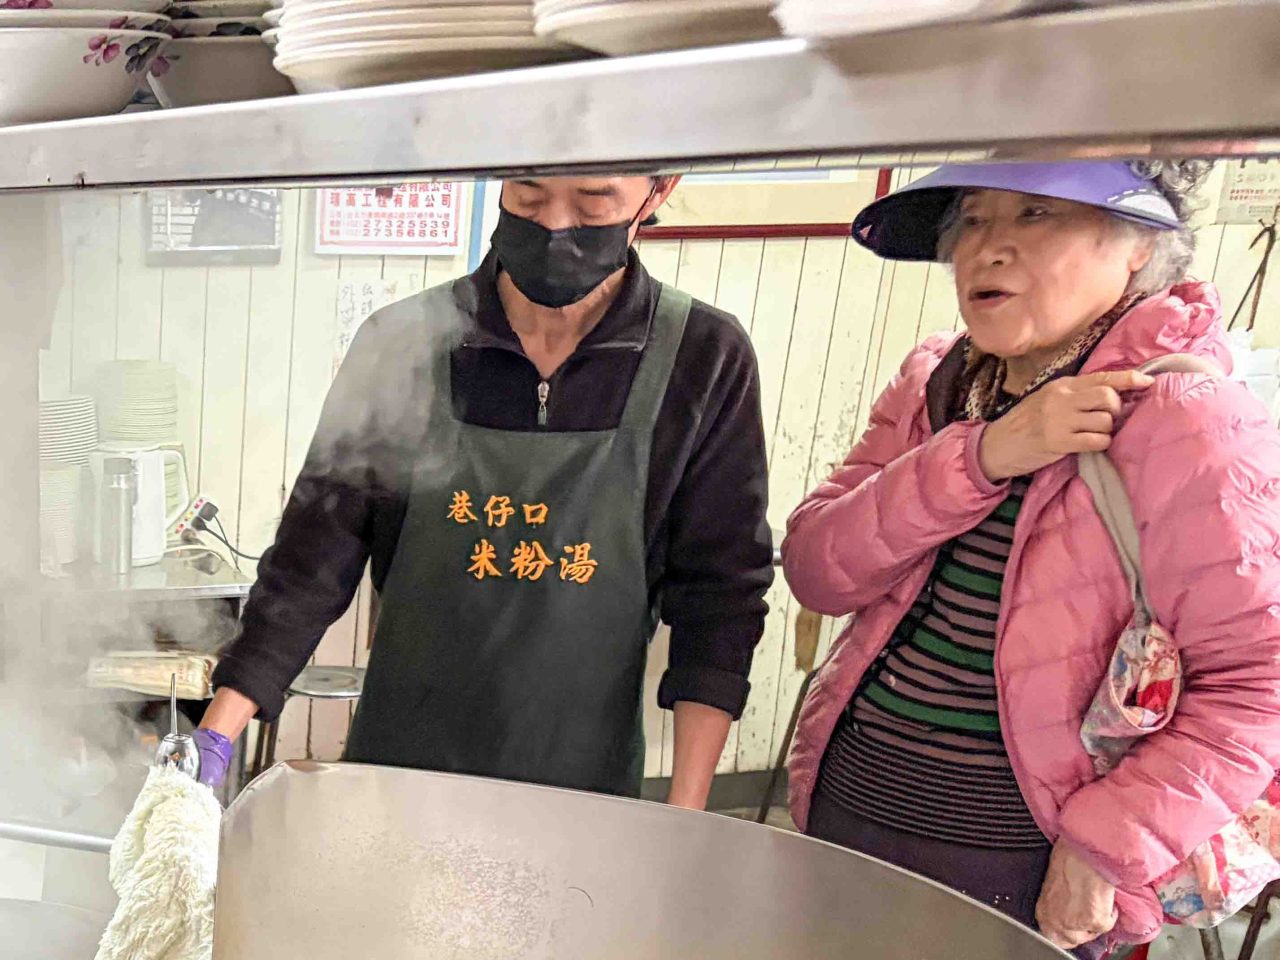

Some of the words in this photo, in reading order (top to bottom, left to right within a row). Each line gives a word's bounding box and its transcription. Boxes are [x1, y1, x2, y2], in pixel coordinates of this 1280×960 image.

[446, 490, 549, 528] 巷仔口
[467, 538, 598, 584] 米粉湯
